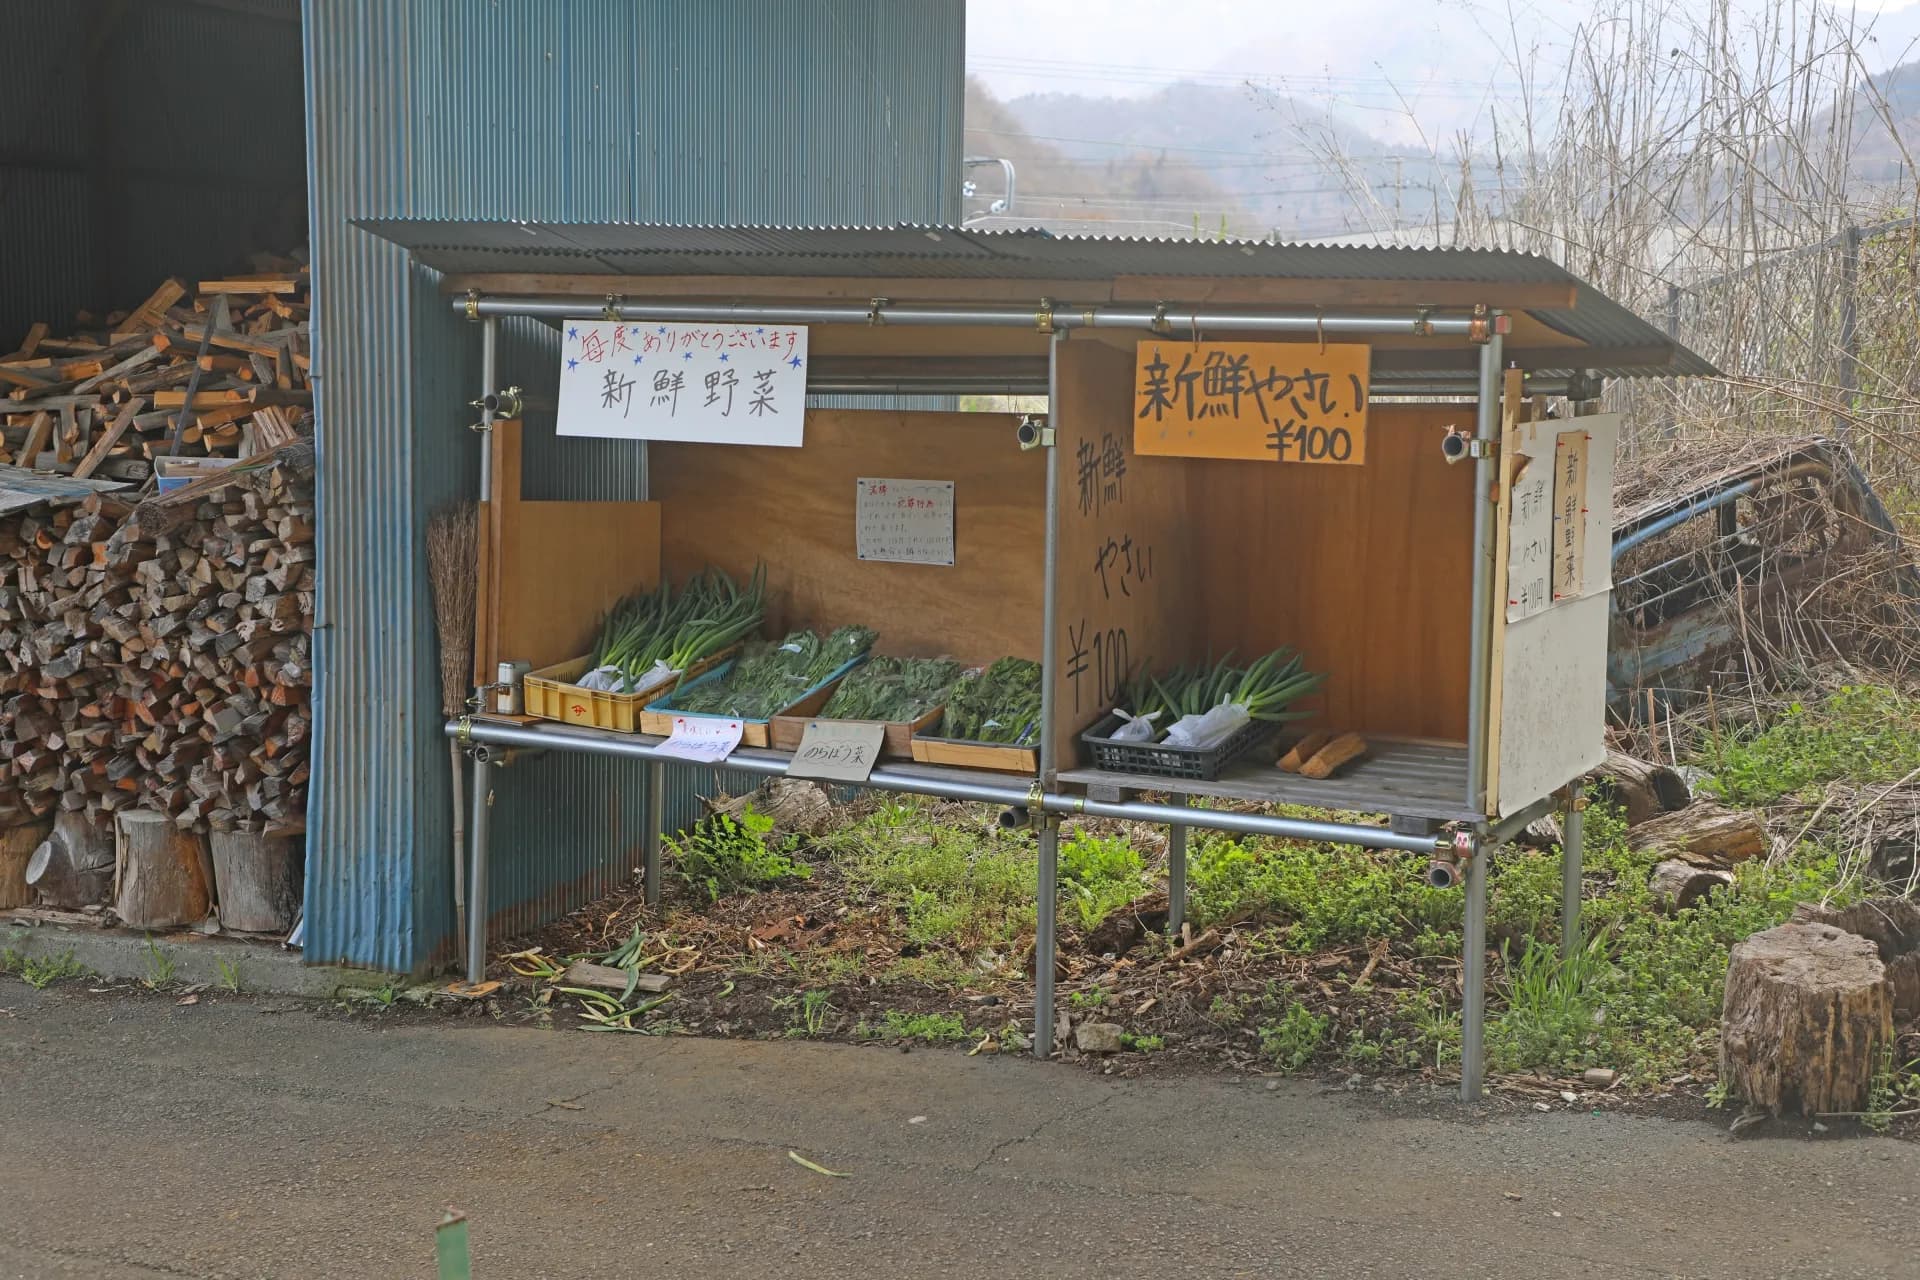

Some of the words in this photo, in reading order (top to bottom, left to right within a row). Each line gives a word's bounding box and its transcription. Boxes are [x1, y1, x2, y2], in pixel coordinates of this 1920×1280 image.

[601, 368, 779, 418] 新鮮野菜
[1138, 350, 1364, 424] 新鮮やさい
[1077, 432, 1126, 518] 新鮮
[1265, 418, 1352, 462] ¥100
[1564, 448, 1579, 588] 新鮮野菜
[1094, 533, 1152, 600] やさい
